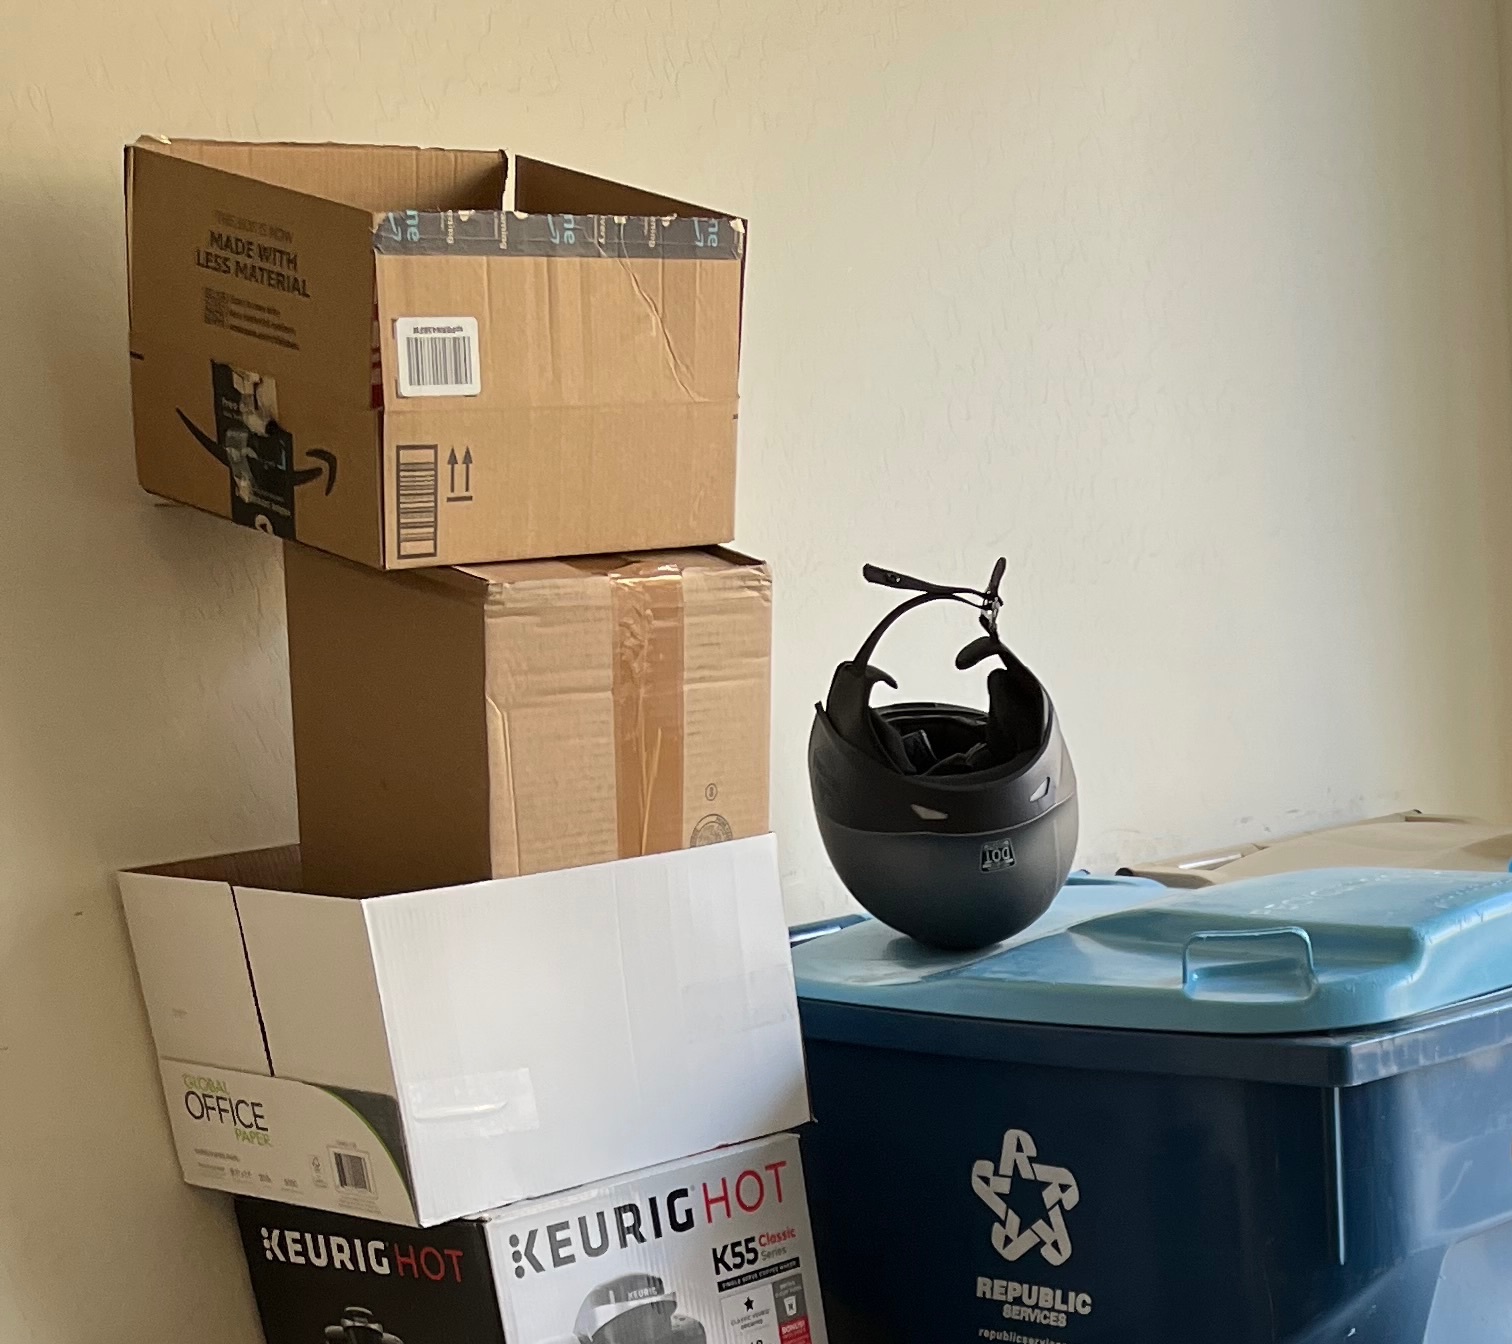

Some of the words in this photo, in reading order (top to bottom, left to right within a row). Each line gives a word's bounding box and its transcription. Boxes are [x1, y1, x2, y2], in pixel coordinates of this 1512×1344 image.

[208, 229, 254, 259] MADE
[257, 243, 298, 273] WITH
[194, 248, 231, 275] LESS
[234, 260, 311, 298] MATERIAL
[182, 1073, 227, 1094] GLOBAL
[184, 1090, 269, 1132] OFFICE
[234, 1128, 272, 1146] PAPER
[509, 1187, 695, 1279] KEURIG
[702, 1160, 787, 1224] HOT
[261, 1227, 390, 1275] KEURIG
[394, 1243, 464, 1283] HOT
[712, 1235, 759, 1275] K55
[758, 1226, 797, 1247] Classic
[760, 1246, 788, 1261] Series
[976, 1276, 1092, 1315] REPUBLIC
[1002, 1303, 1067, 1328] SERVICES
